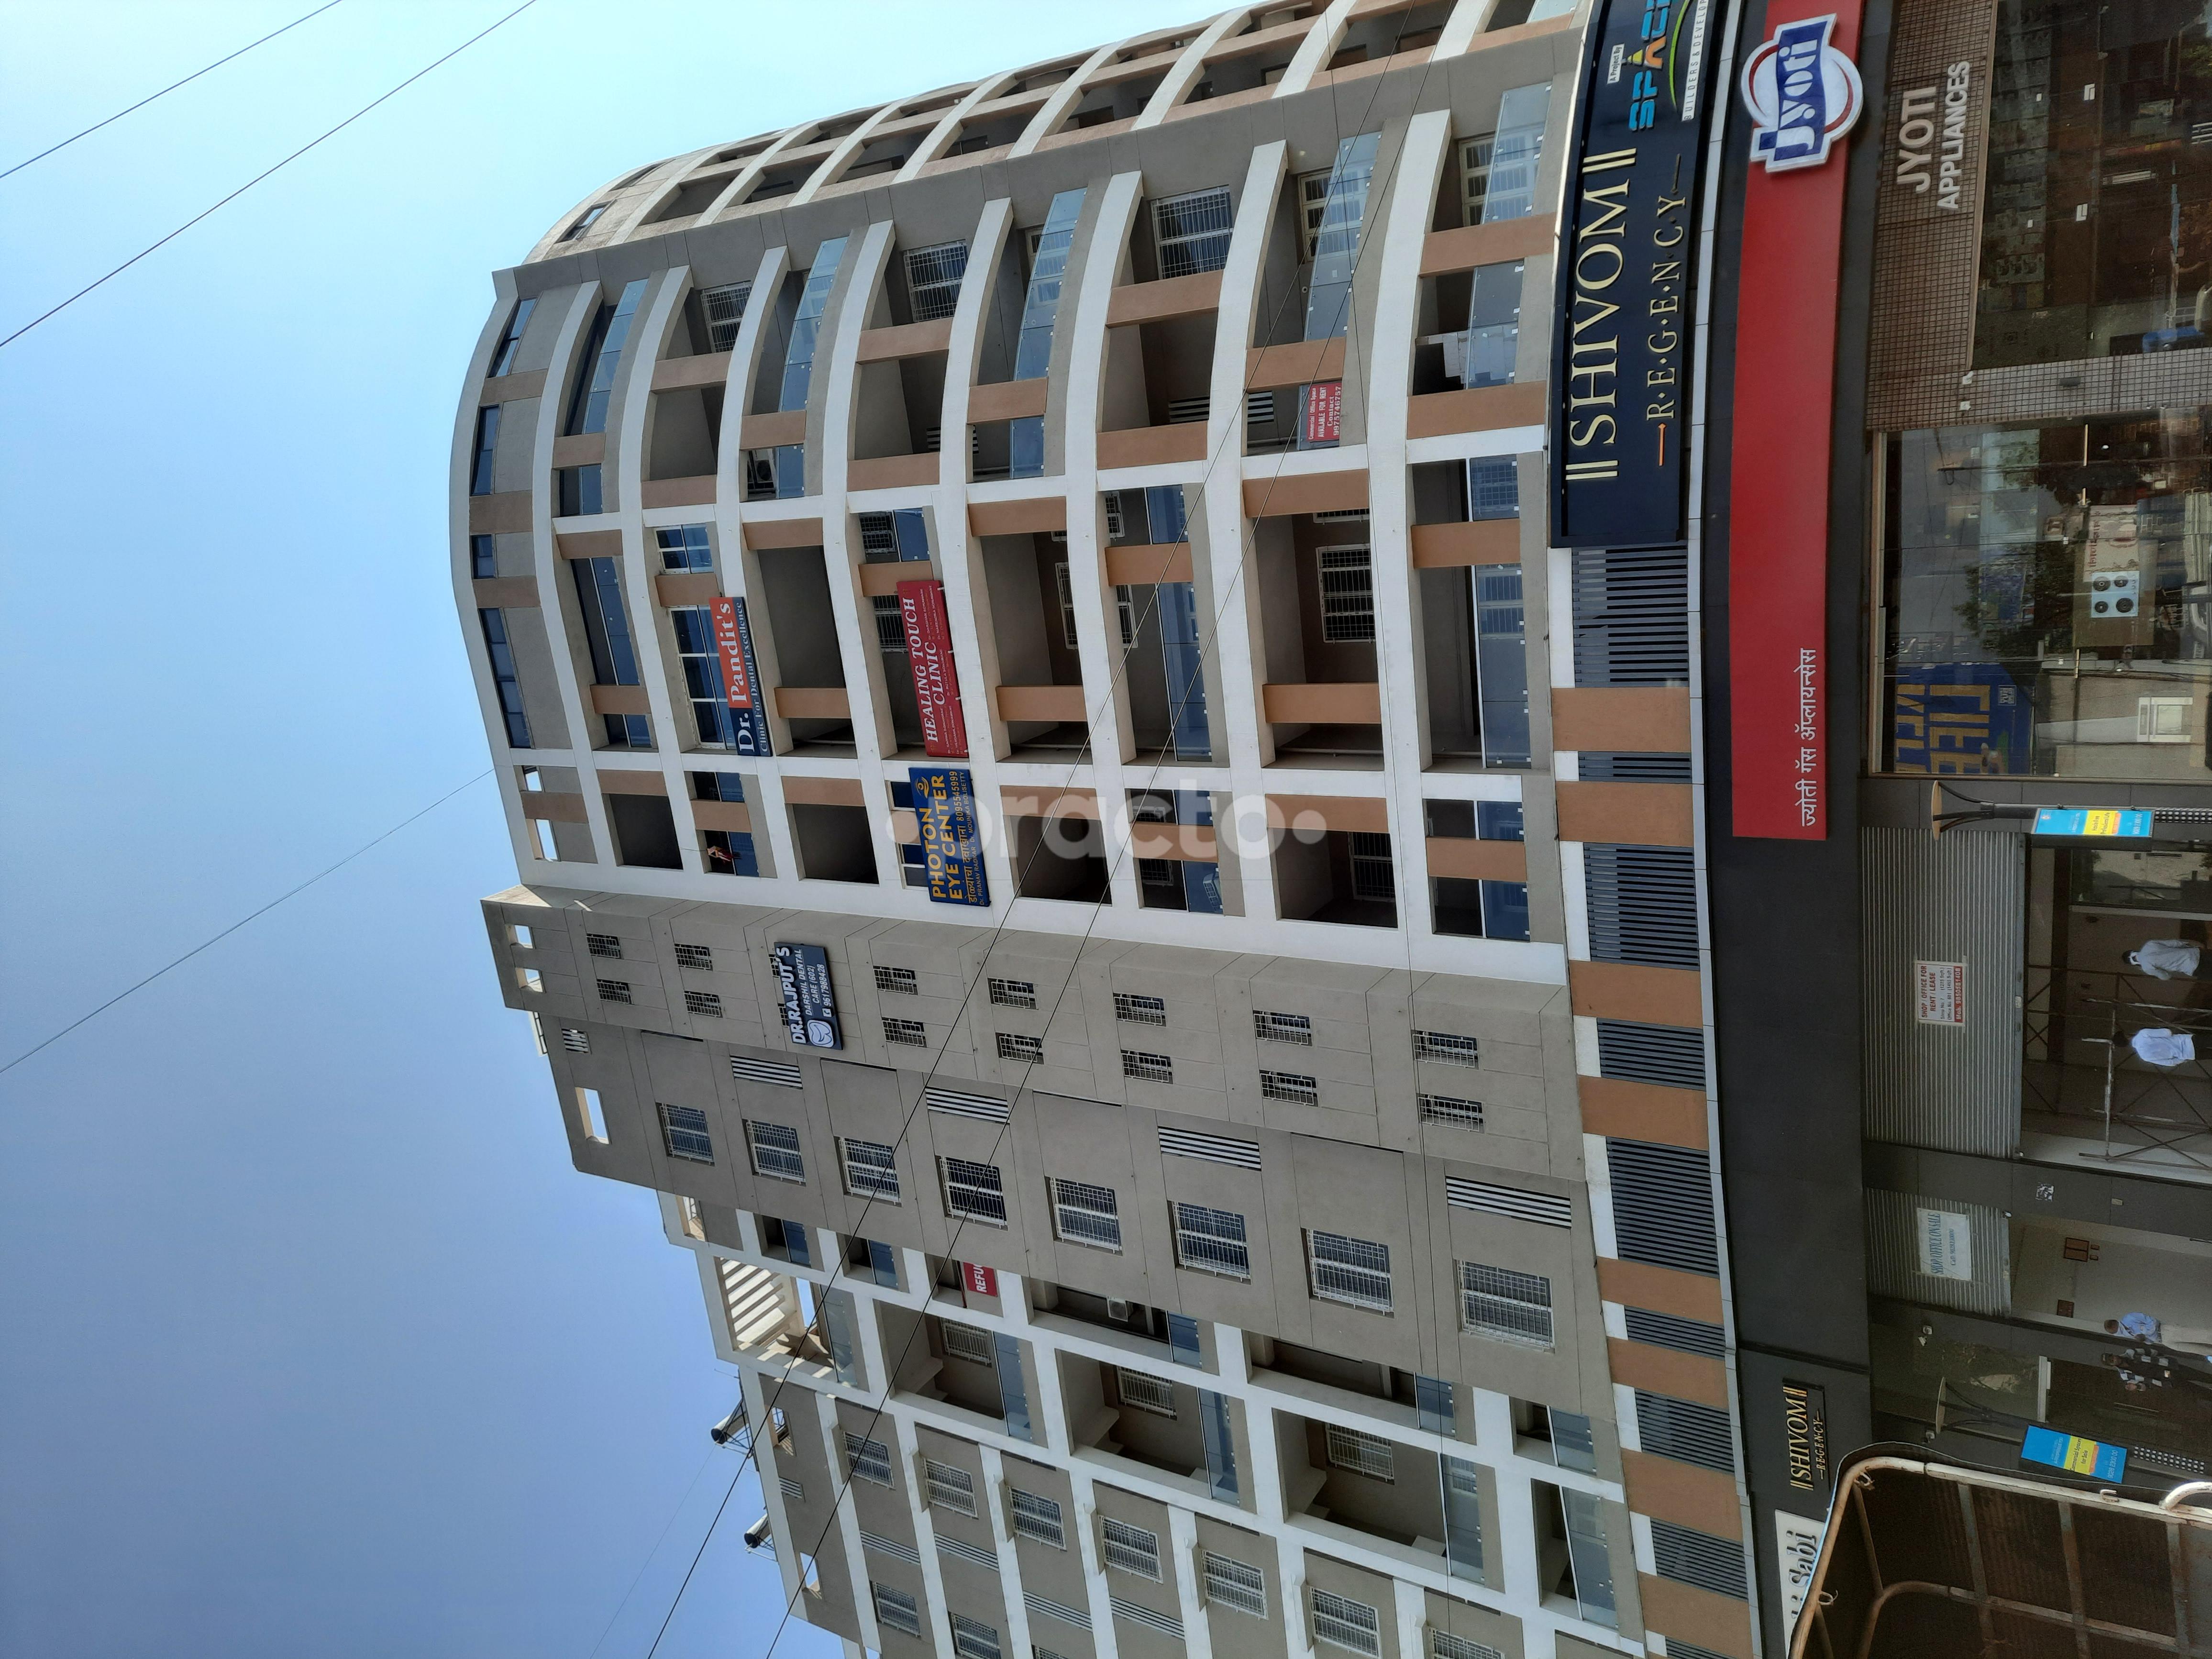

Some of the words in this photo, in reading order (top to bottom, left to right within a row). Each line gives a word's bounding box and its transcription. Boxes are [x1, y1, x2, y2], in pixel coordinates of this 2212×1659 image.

[1611, 55, 1620, 76] Project
[1683, 61, 1699, 120] BUILDERS
[1896, 86, 1936, 194] JYOTI
[1937, 60, 1970, 209] APPLIANCES
[1569, 178, 1629, 446] SHIVOM
[1317, 413, 1326, 437] AVAILABLE
[735, 602, 751, 658] Excellence
[902, 597, 924, 659] TOUCH
[716, 602, 748, 703] Pandit's
[745, 662, 758, 696] Dental
[924, 641, 946, 705] CLINIC
[752, 699, 762, 718] For
[914, 664, 939, 742] HEALING
[737, 712, 755, 752] Dr.
[758, 721, 768, 752] Clinic
[1795, 746, 1817, 773] गॅस
[949, 771, 965, 821] 8095545999
[959, 771, 969, 804] BOLISETTY
[1794, 778, 1817, 827] ज्योती
[930, 774, 956, 857] CENTER
[965, 806, 974, 833] MOUNIKA
[918, 807, 947, 898] PHOTON
[957, 825, 972, 863] दवाखाना
[945, 863, 963, 899] EYE
[974, 873, 984, 896] PRANAV
[794, 949, 806, 980] DENTAL
[807, 965, 818, 983] (602)
[801, 982, 812, 1016] DARSHIL
[810, 984, 820, 1004] CARE
[1928, 1213, 1941, 1228] SALE
[1785, 1397, 1812, 1480] SHIVOM
